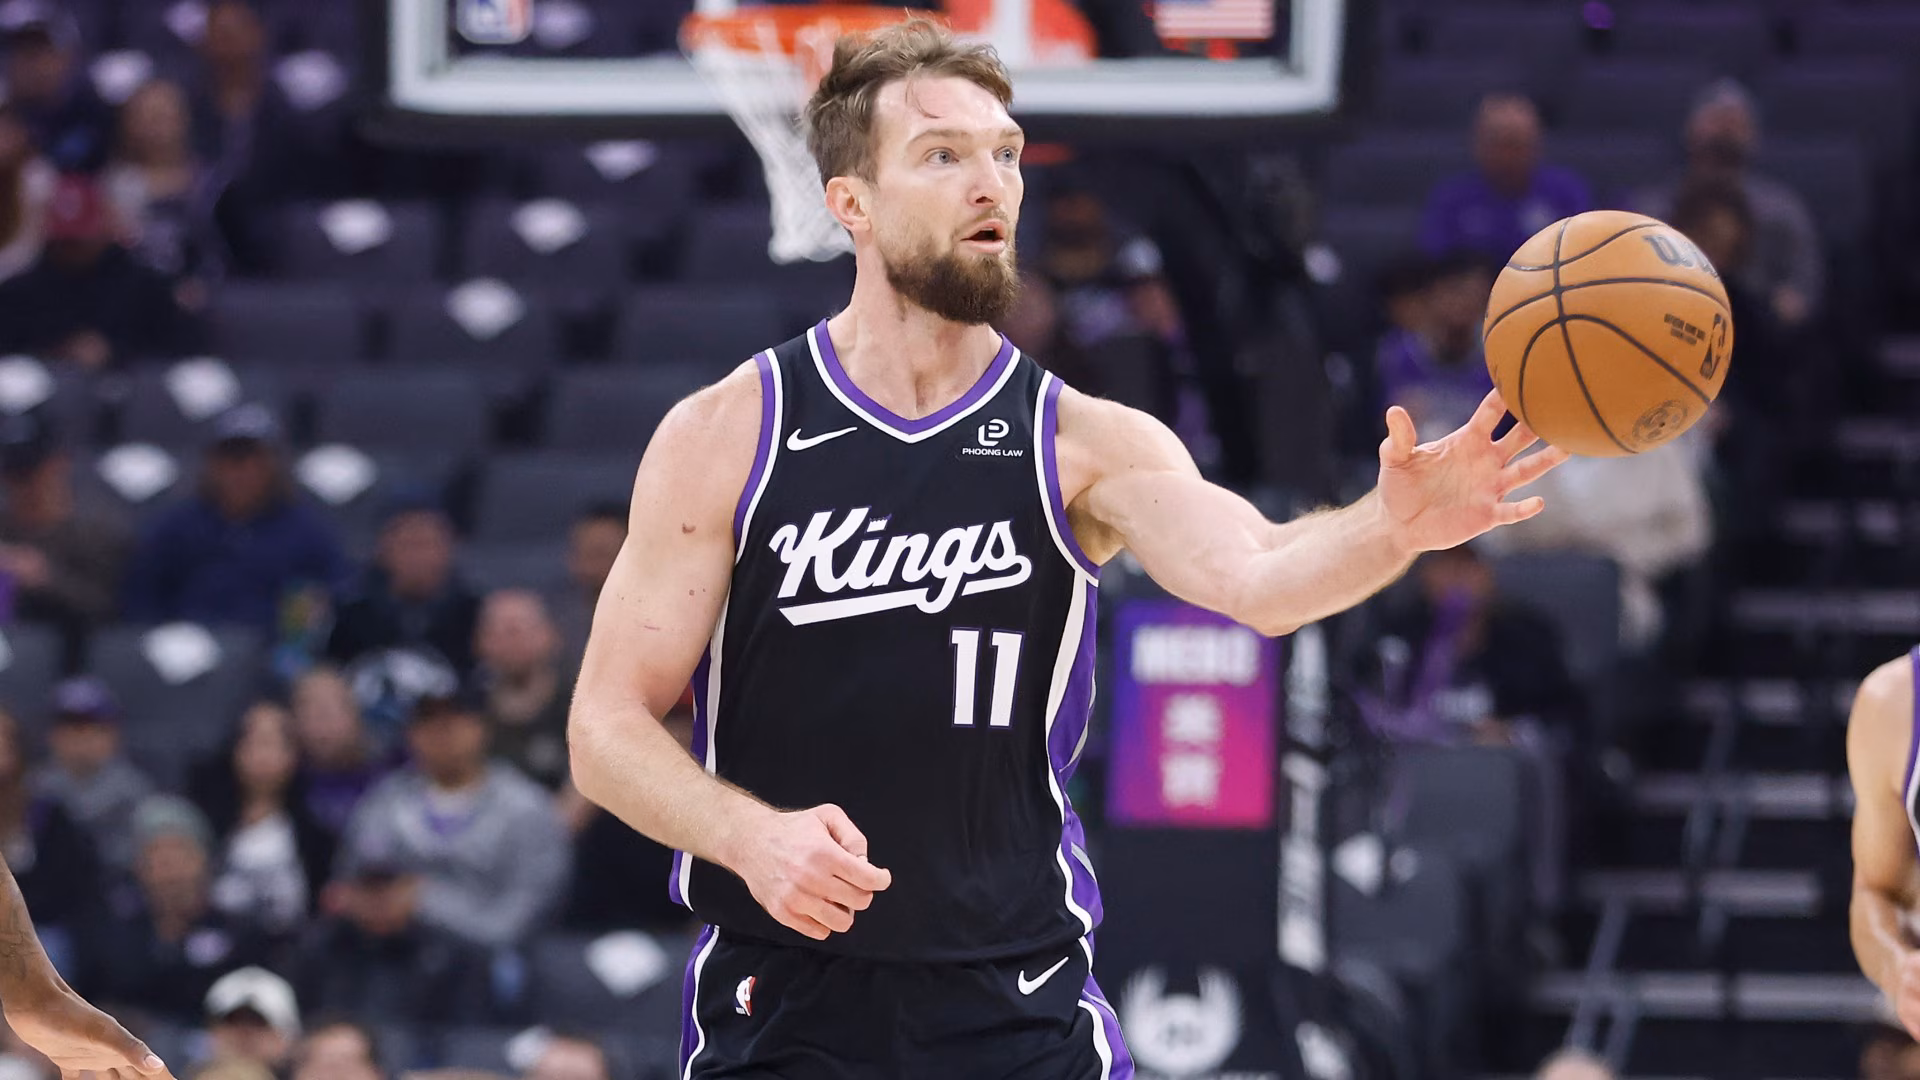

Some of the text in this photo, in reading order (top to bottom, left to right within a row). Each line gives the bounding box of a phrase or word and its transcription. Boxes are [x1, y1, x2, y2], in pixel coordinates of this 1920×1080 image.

[962, 447, 1024, 457] PHOONG LAW
[768, 506, 1032, 625] Kings
[951, 628, 1024, 728] 11
